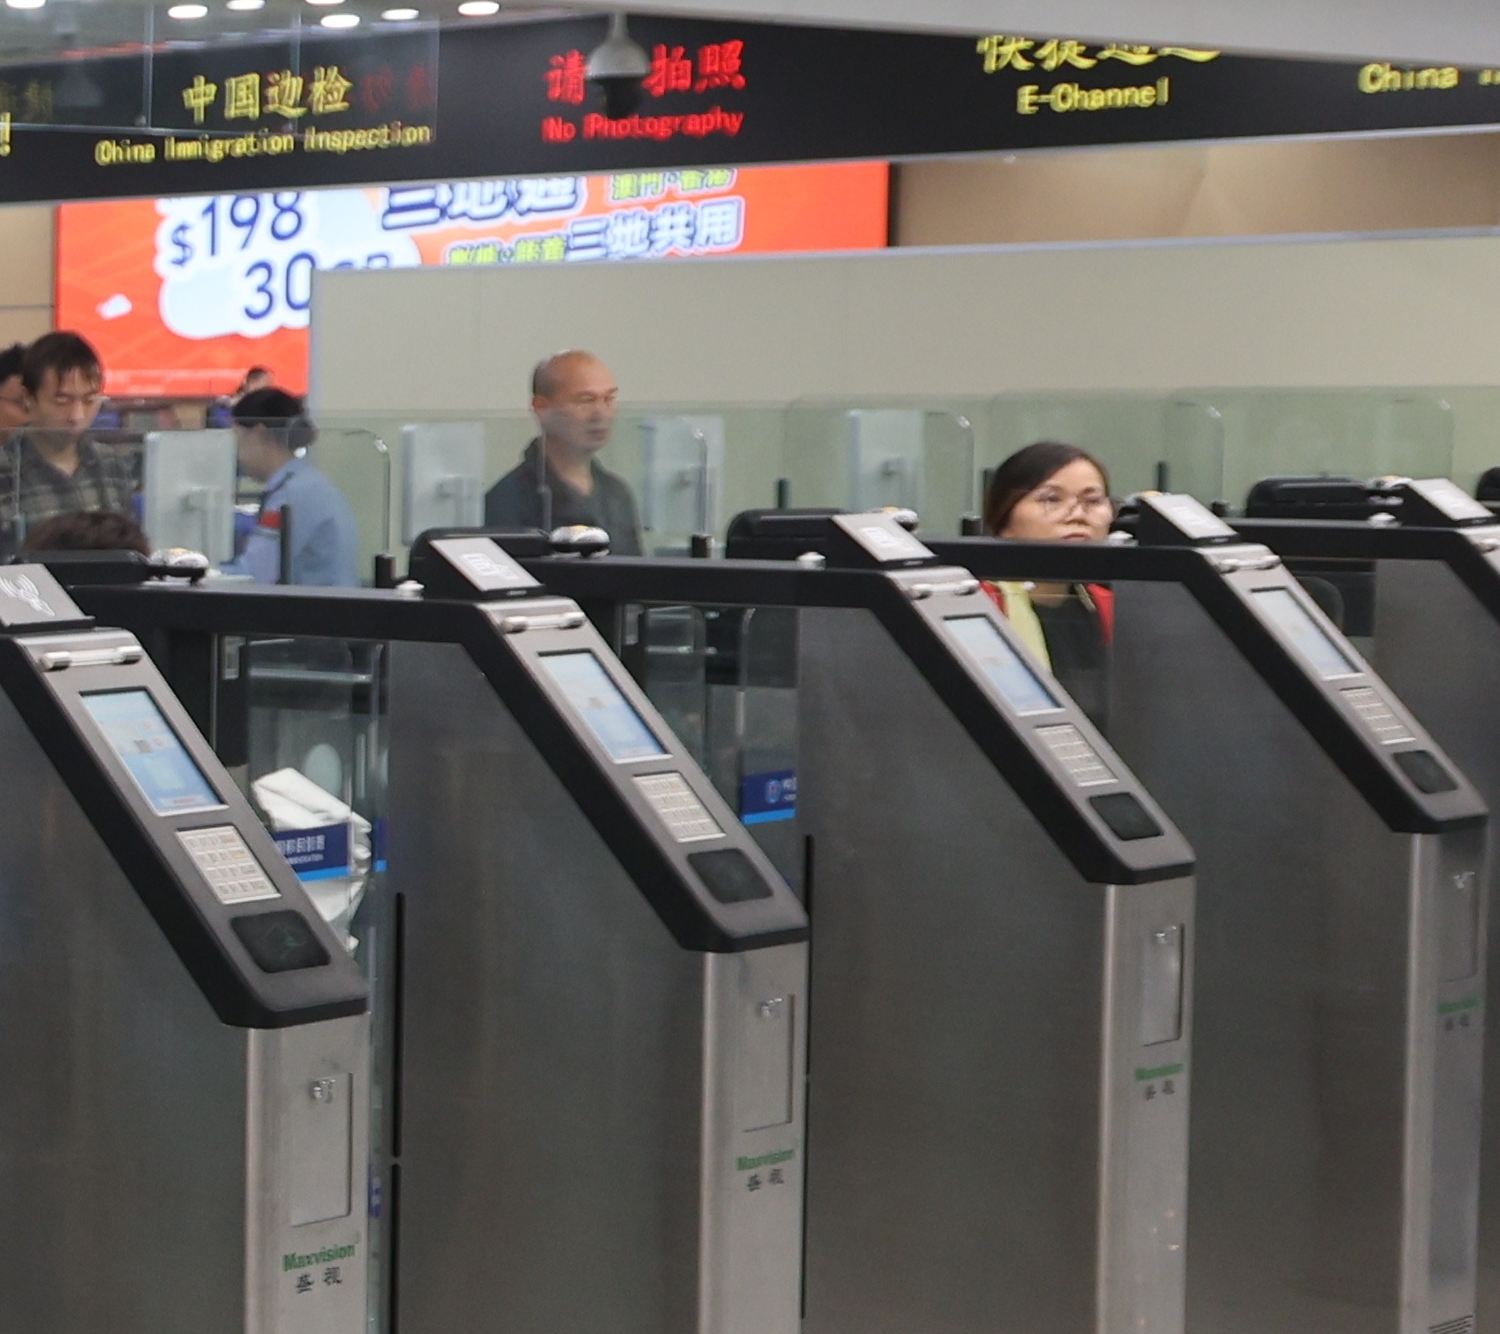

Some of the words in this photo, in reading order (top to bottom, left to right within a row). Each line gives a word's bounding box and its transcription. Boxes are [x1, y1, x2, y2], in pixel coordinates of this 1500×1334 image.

[182, 65, 353, 125] 中国边检
[542, 40, 746, 105] 请拍照
[1016, 77, 1170, 115] E-Channel
[94, 138, 156, 166] China
[164, 131, 295, 162] Immigration
[304, 121, 432, 155] Inspection
[541, 116, 578, 143] No
[582, 106, 745, 142] Photography
[171, 191, 303, 266] $198
